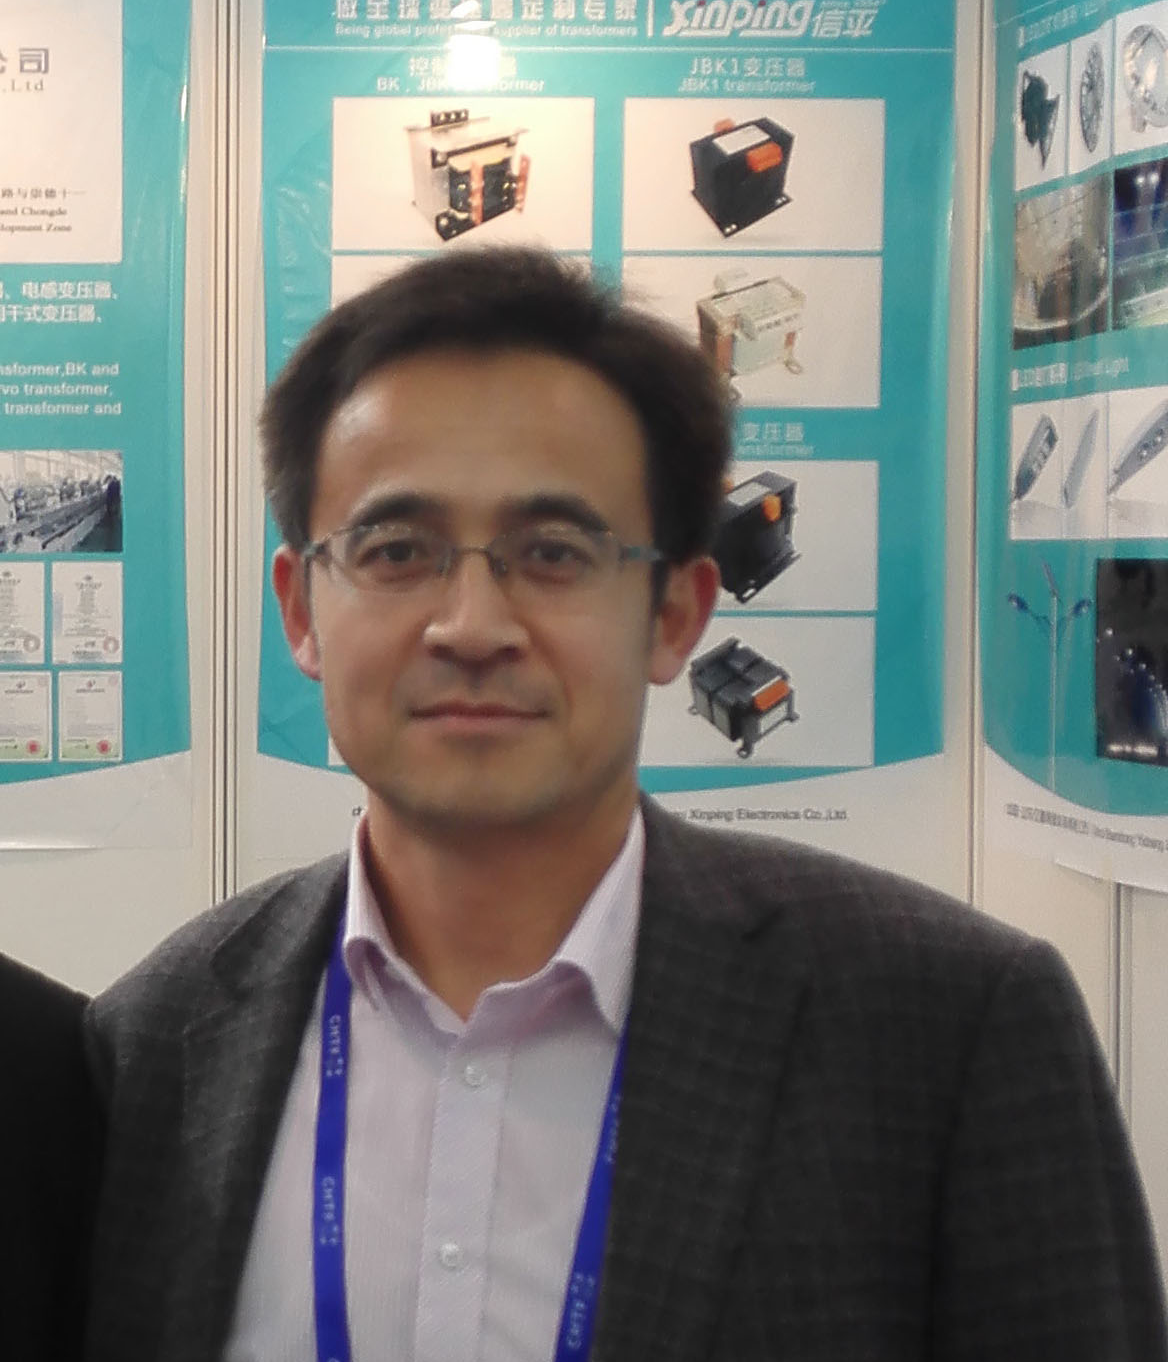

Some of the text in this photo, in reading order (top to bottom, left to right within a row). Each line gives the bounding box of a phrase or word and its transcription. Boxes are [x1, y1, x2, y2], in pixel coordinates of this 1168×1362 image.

[91, 363, 120, 376] and
[4, 402, 89, 416] transformer
[94, 402, 122, 416] and
